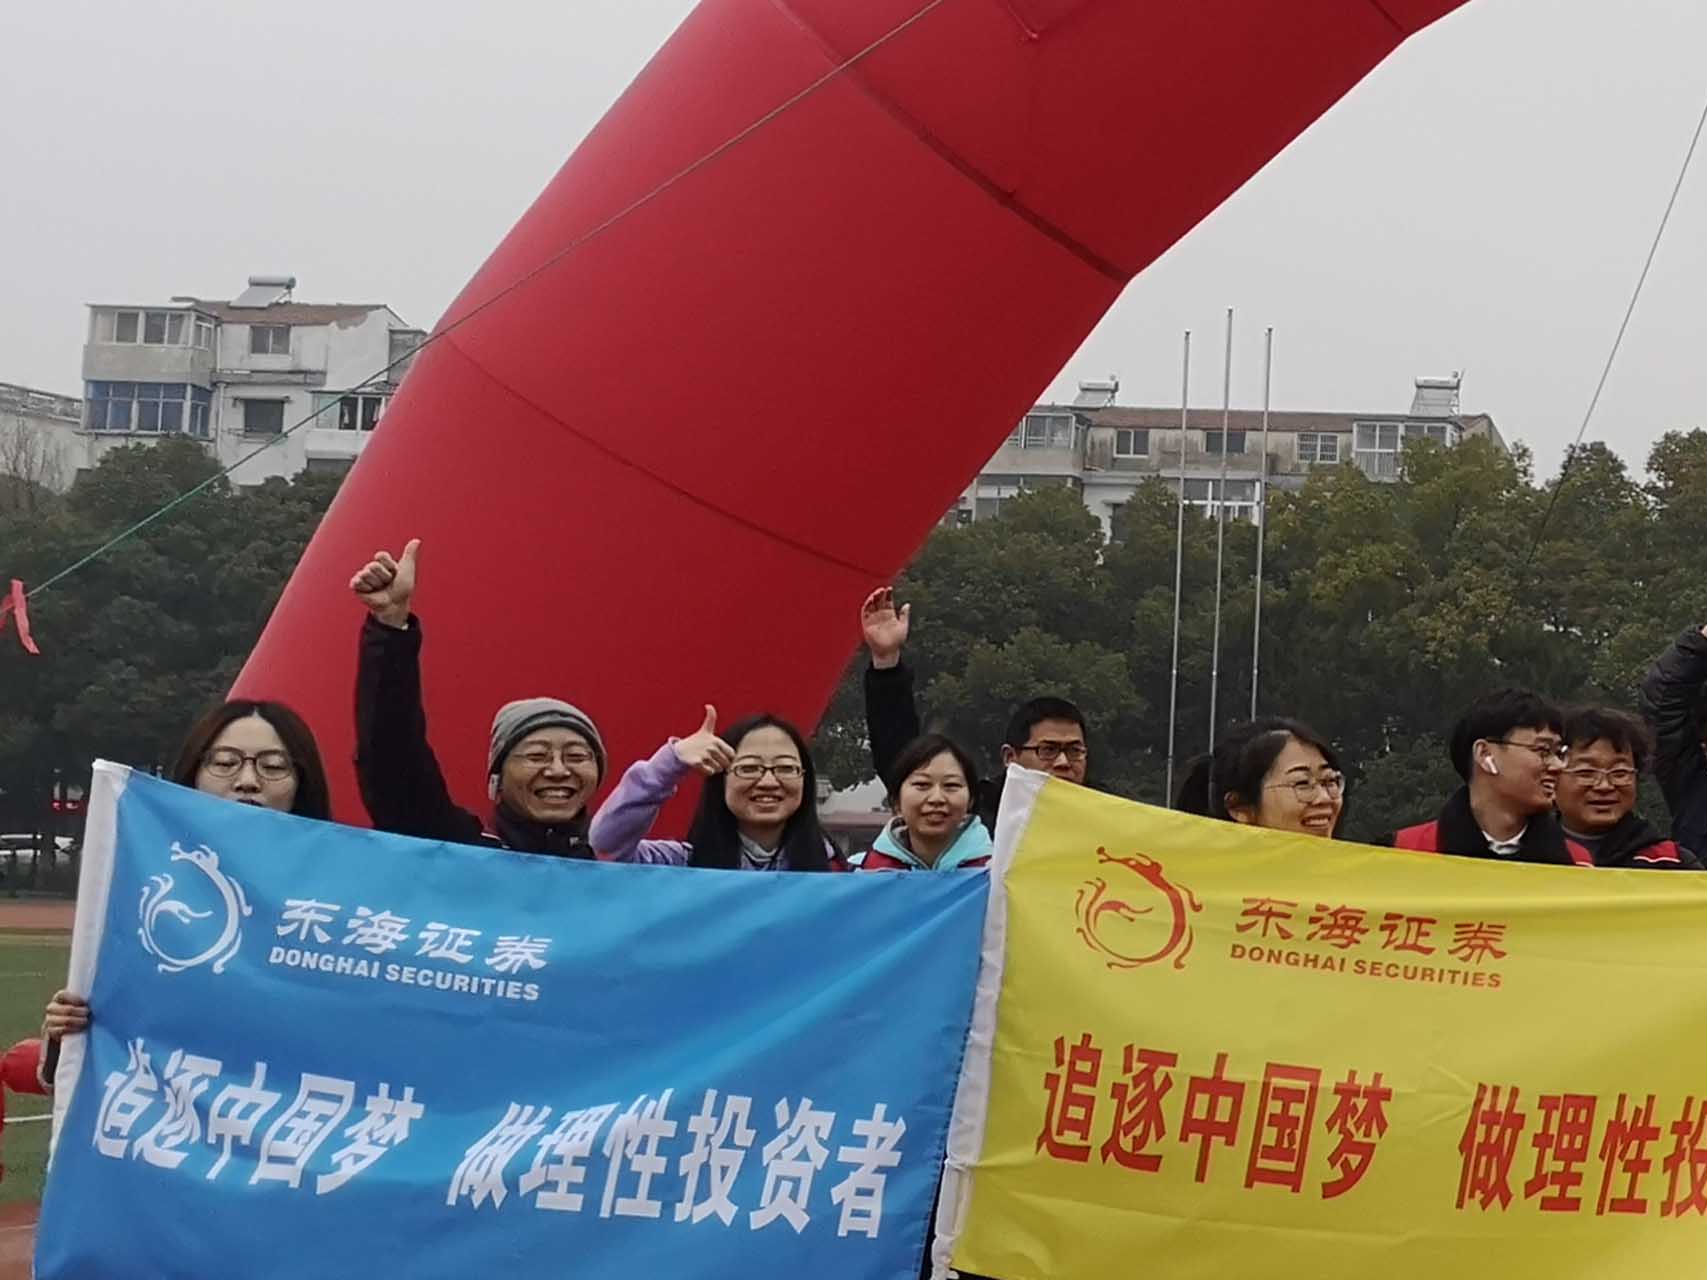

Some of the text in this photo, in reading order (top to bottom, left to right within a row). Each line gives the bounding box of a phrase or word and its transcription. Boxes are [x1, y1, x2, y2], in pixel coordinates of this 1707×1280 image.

[274, 898, 552, 973] 东海证券
[1230, 943, 1503, 989] DONGHAI SECURITIES
[1234, 897, 1508, 966] 东海证券
[269, 946, 540, 1001] DONGHAI SECURITIES
[92, 1036, 907, 1238] 追逐中国梦 做理性投资者
[1035, 1032, 1393, 1200] 追逐中国梦
